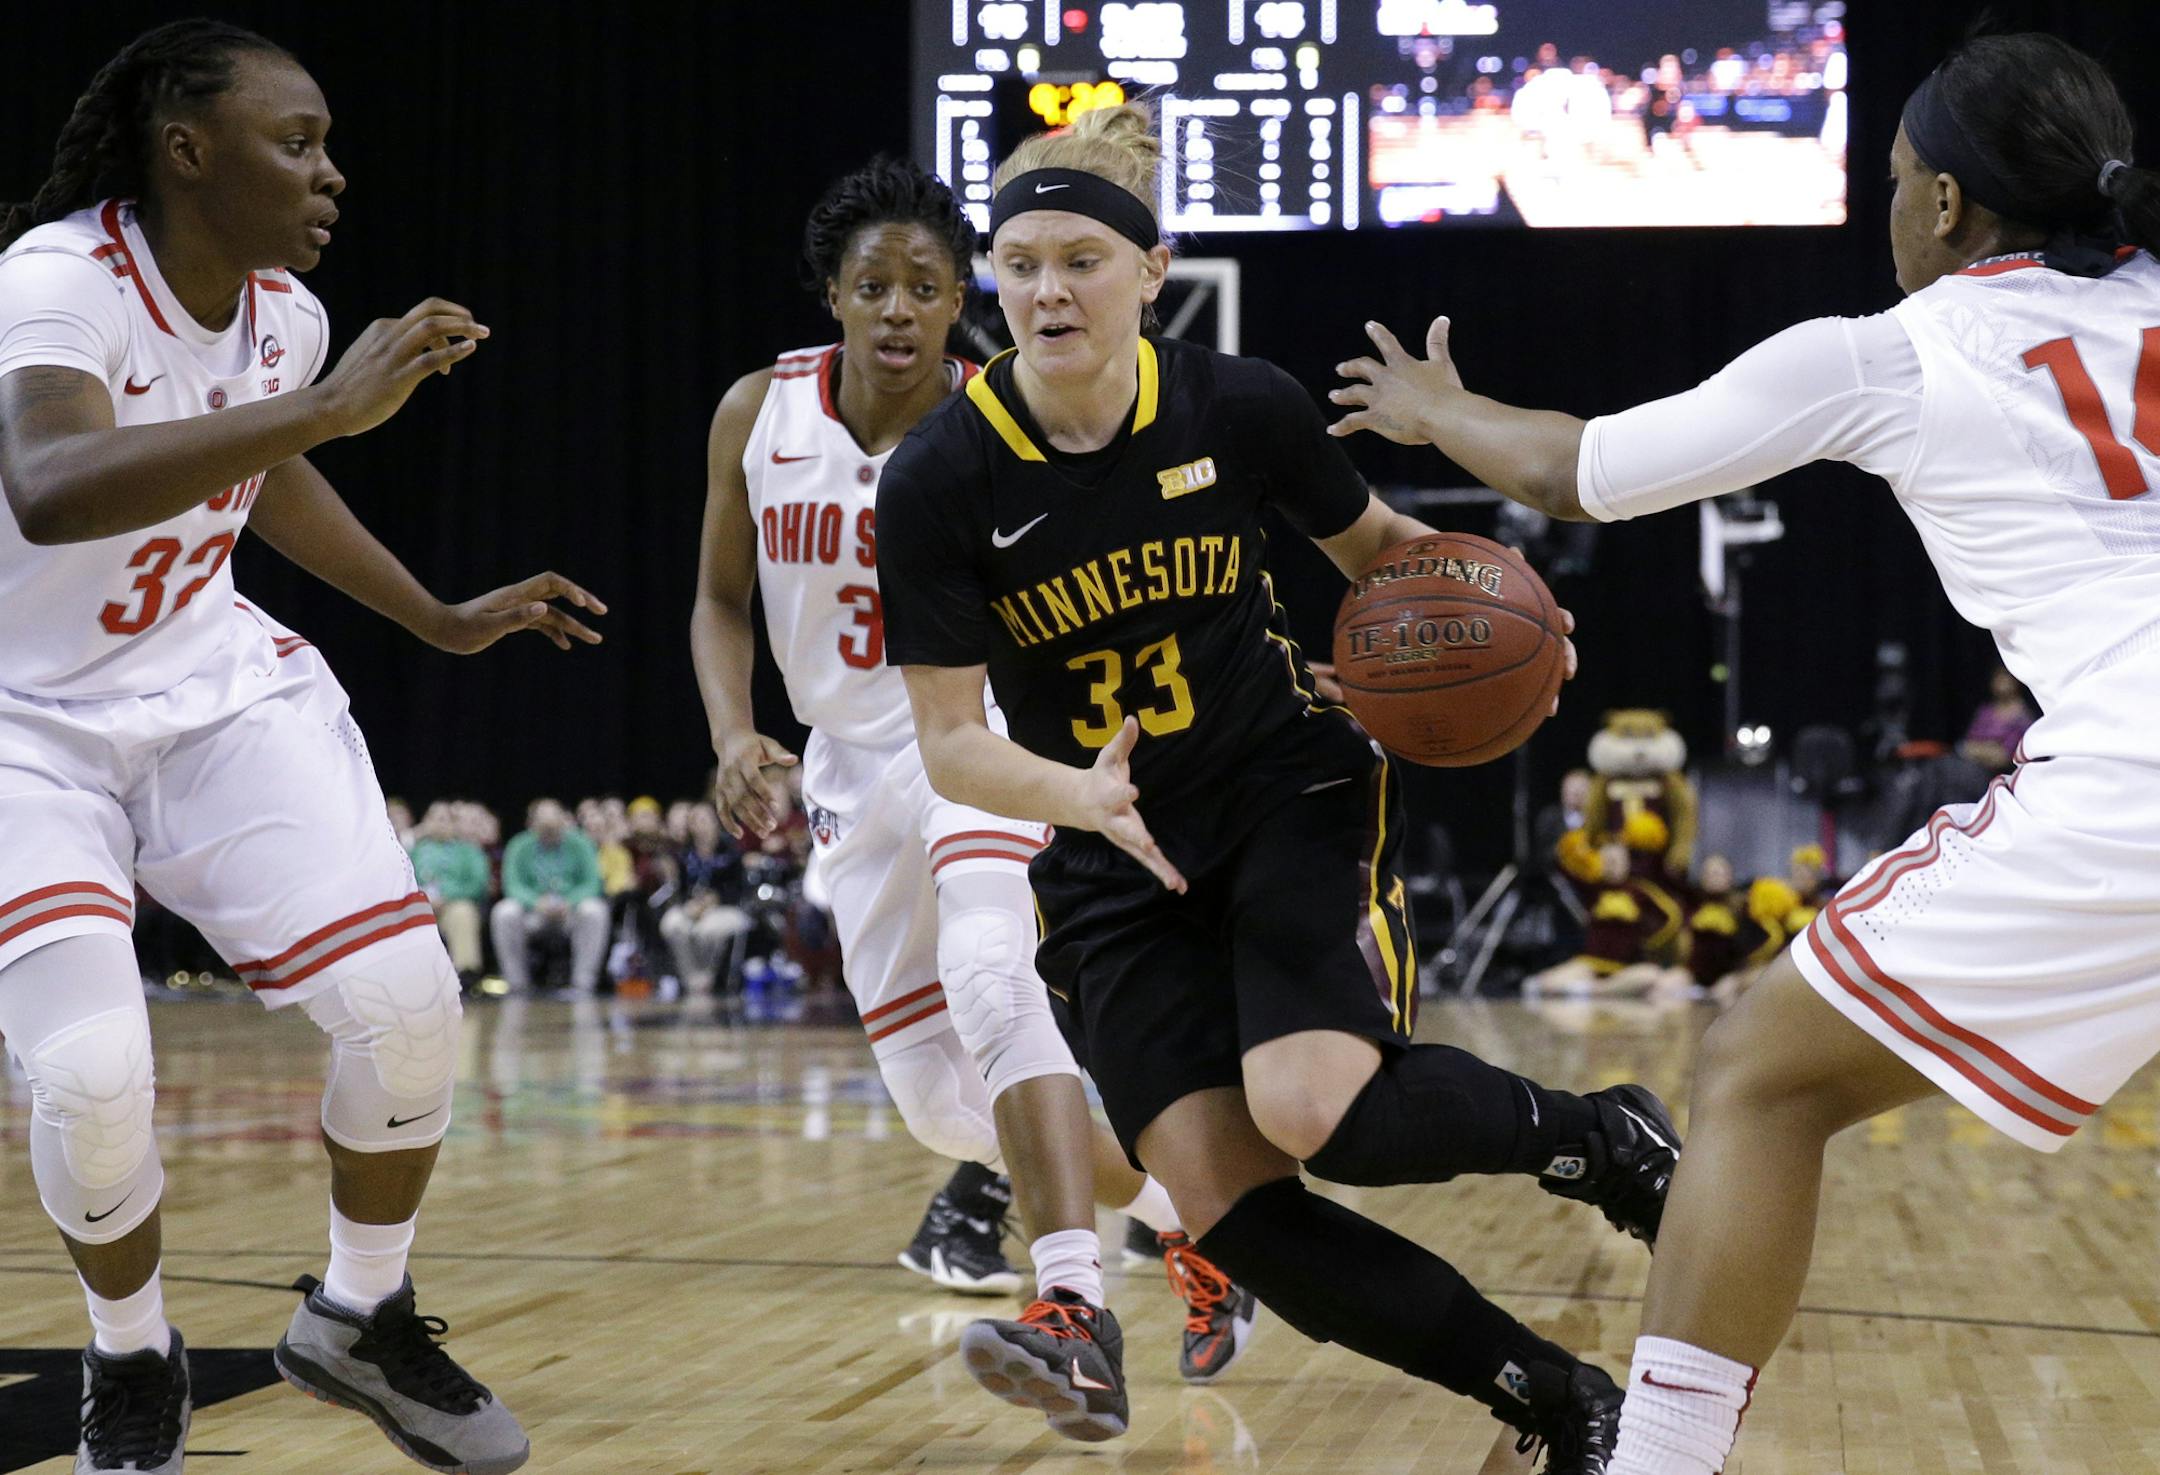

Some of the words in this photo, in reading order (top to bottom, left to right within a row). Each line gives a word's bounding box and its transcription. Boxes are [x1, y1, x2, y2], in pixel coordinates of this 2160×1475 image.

[762, 501, 845, 565] OHIO
[97, 529, 236, 636] 32
[989, 535, 1241, 648] MINNESOTA
[1352, 556, 1505, 600] SPALDING
[1348, 617, 1493, 656] TF-1000
[1065, 631, 1196, 748] 33
